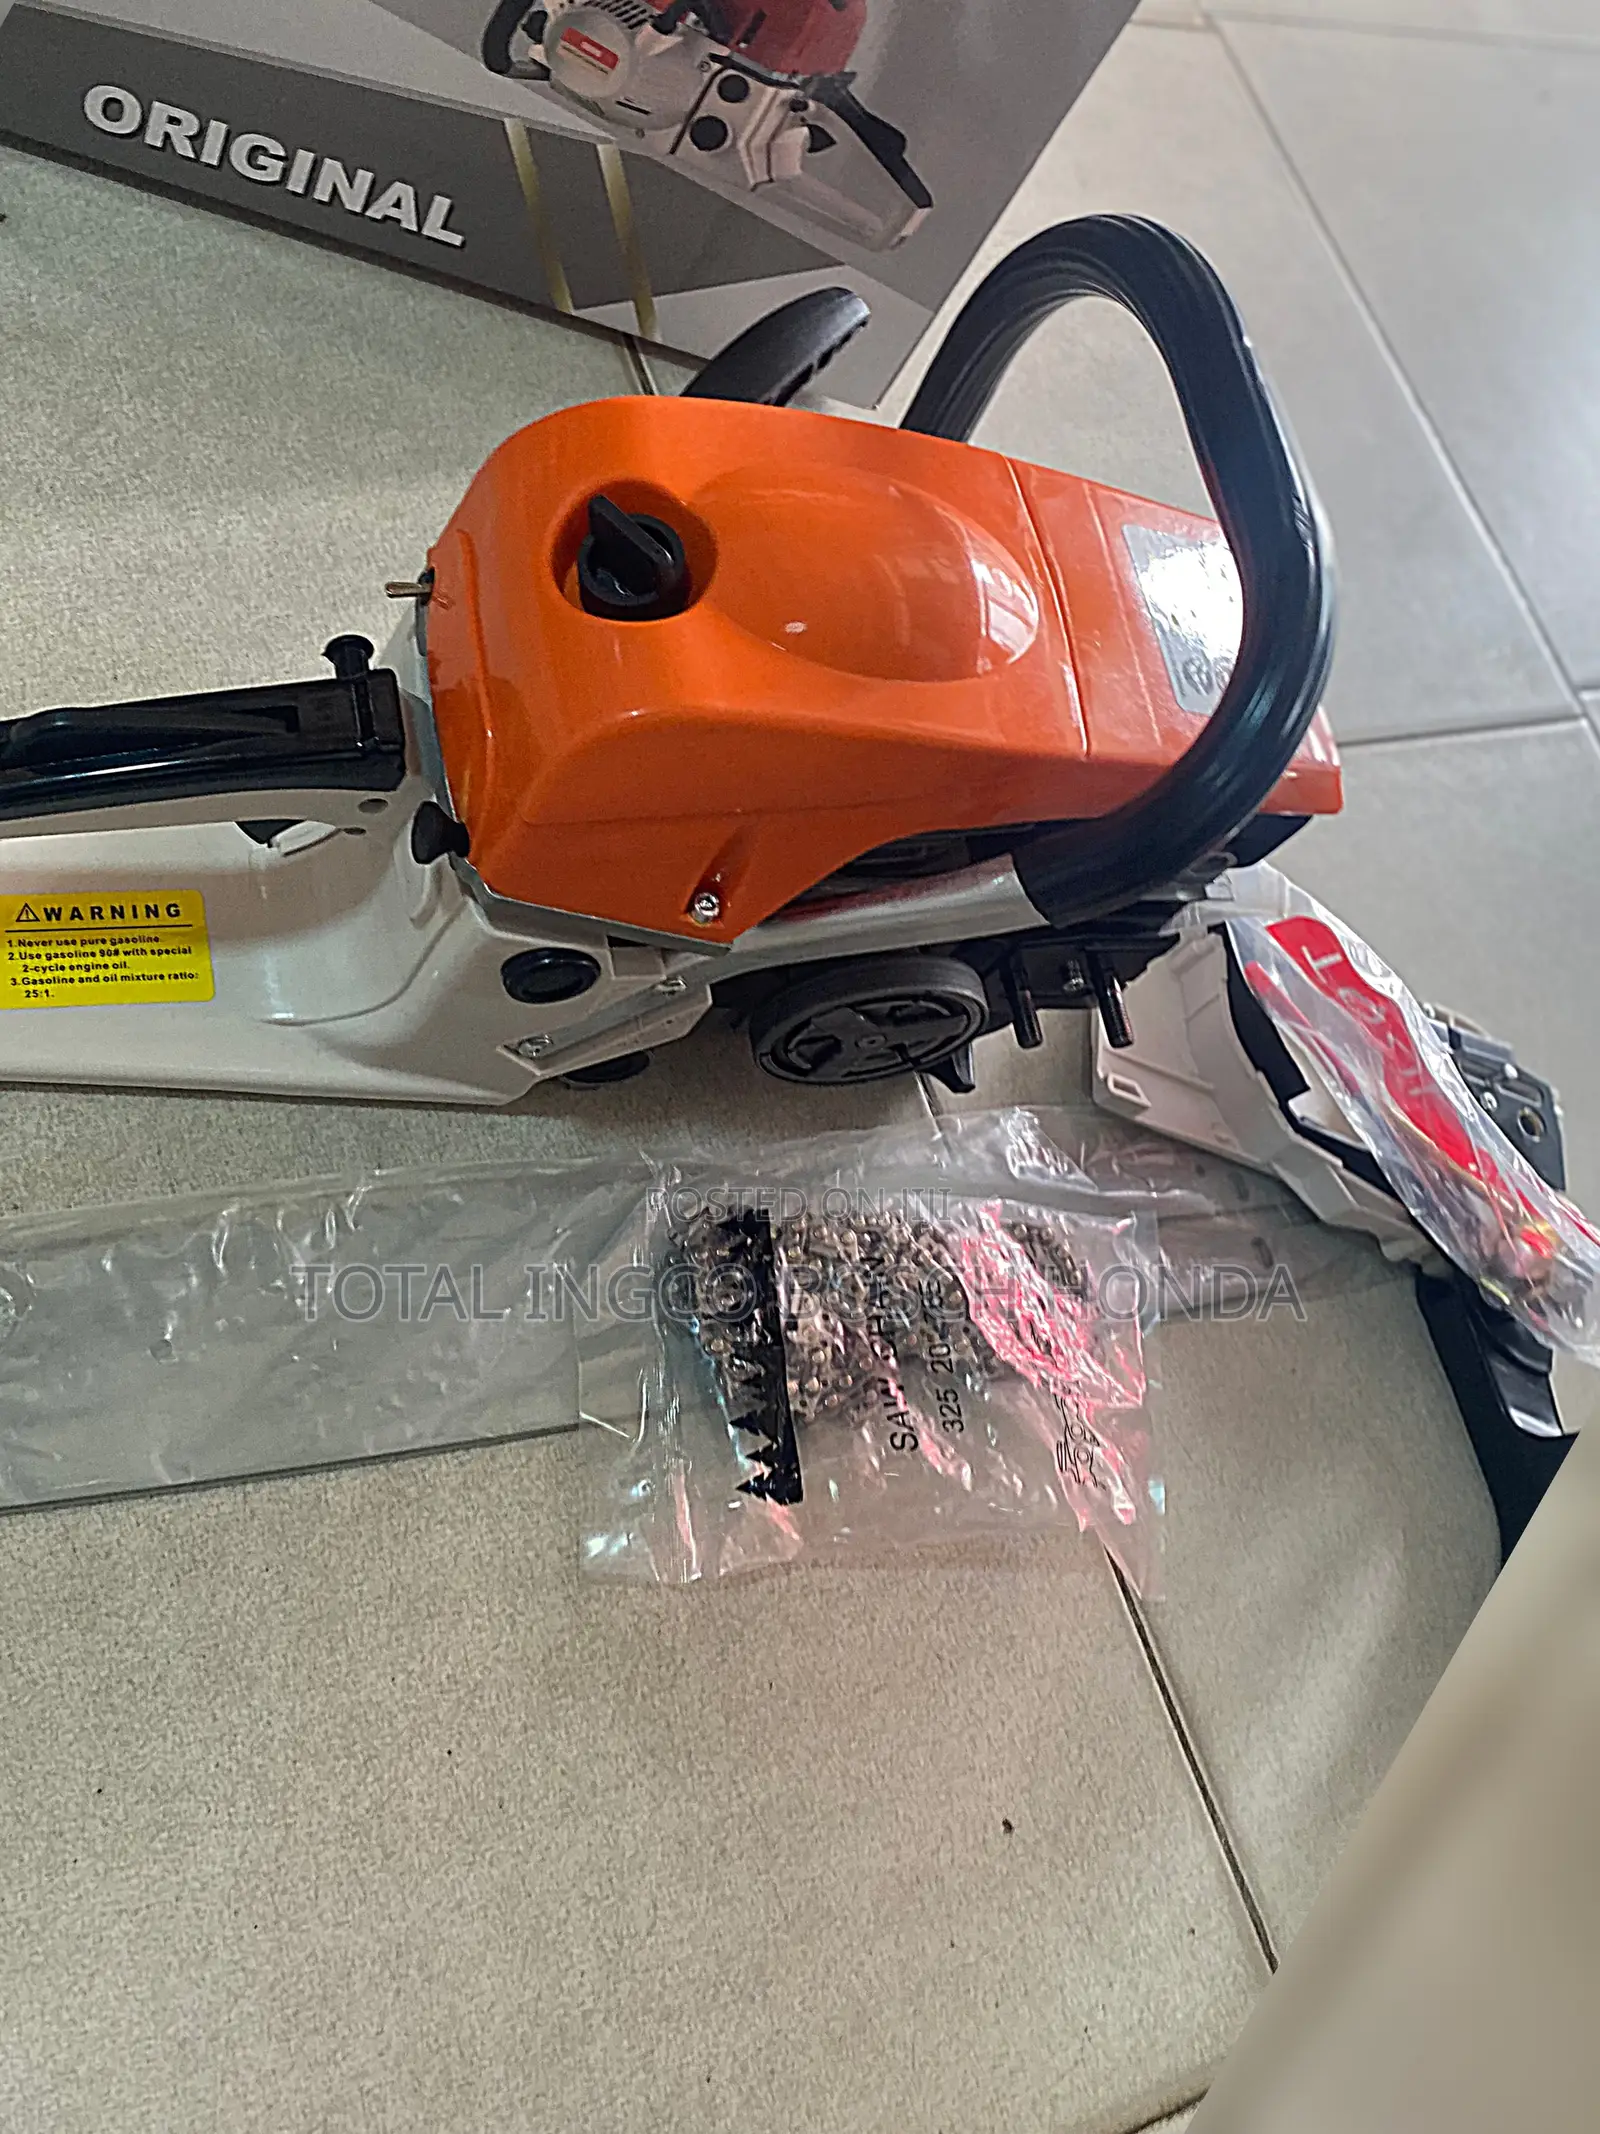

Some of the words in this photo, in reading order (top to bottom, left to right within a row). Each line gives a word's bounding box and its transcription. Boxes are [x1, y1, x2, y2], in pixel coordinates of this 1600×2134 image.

[83, 84, 465, 247] ORIGINAL
[43, 903, 180, 921] WARNING
[56, 938, 77, 946] use
[80, 938, 107, 948] pure
[45, 950, 96, 961] gasoline
[99, 948, 119, 957] 90#
[122, 947, 147, 956] with
[150, 946, 192, 956] special
[22, 963, 65, 973] 2-cycle
[69, 962, 109, 972] engine
[78, 974, 100, 983] and
[103, 973, 118, 982] oil
[120, 973, 165, 981] mixture
[168, 971, 199, 980] ratio:
[877, 1377, 919, 1452] SAW
[936, 1388, 965, 1433] 325
